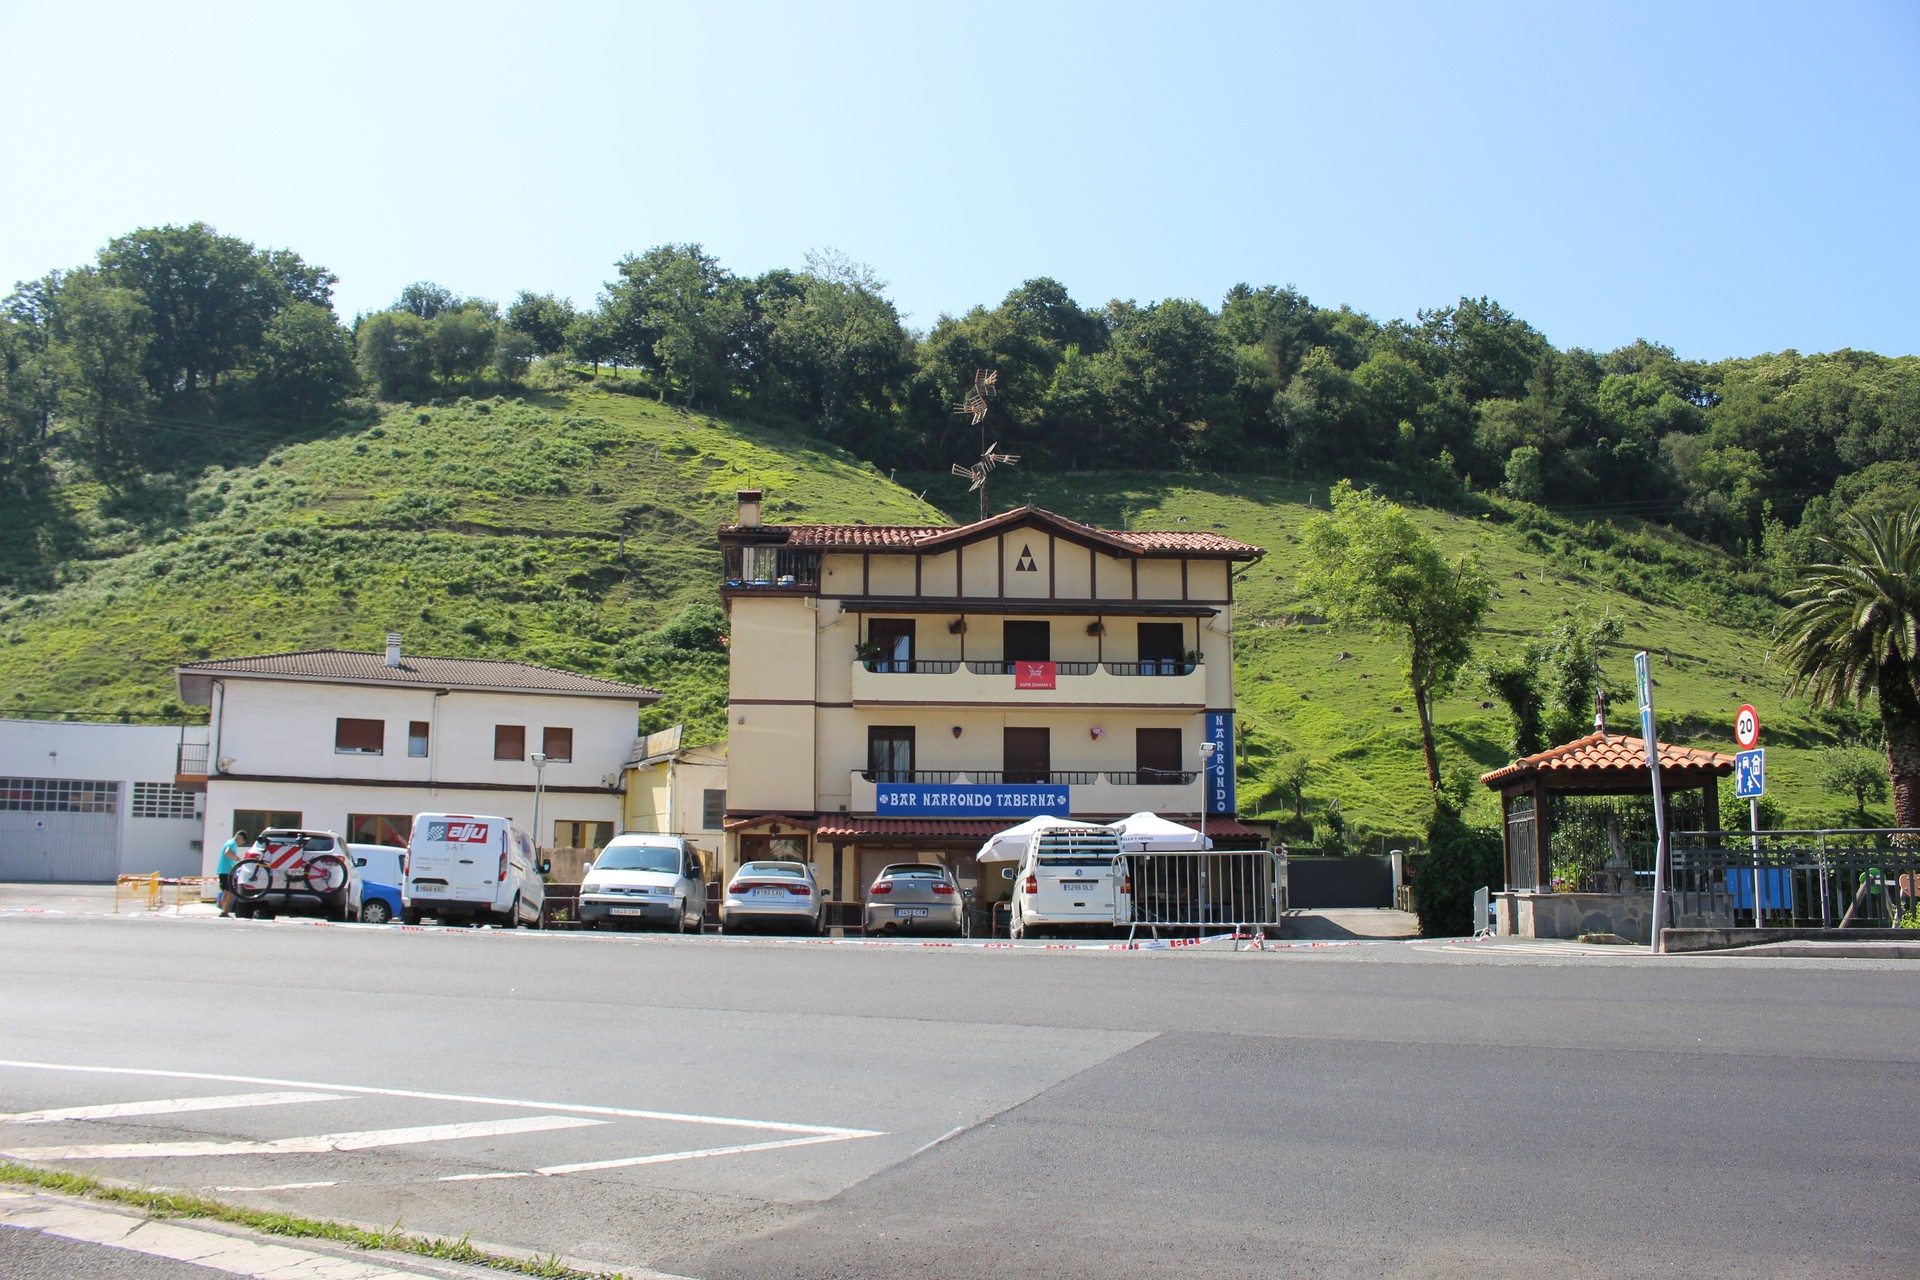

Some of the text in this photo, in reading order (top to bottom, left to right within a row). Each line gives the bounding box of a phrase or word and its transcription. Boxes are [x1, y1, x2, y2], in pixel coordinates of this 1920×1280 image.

[1739, 718, 1752, 734] 20
[1215, 716, 1226, 812] NARRONDO
[890, 793, 1056, 807] BAR NARRONDO TABERNA
[448, 824, 486, 841] alju
